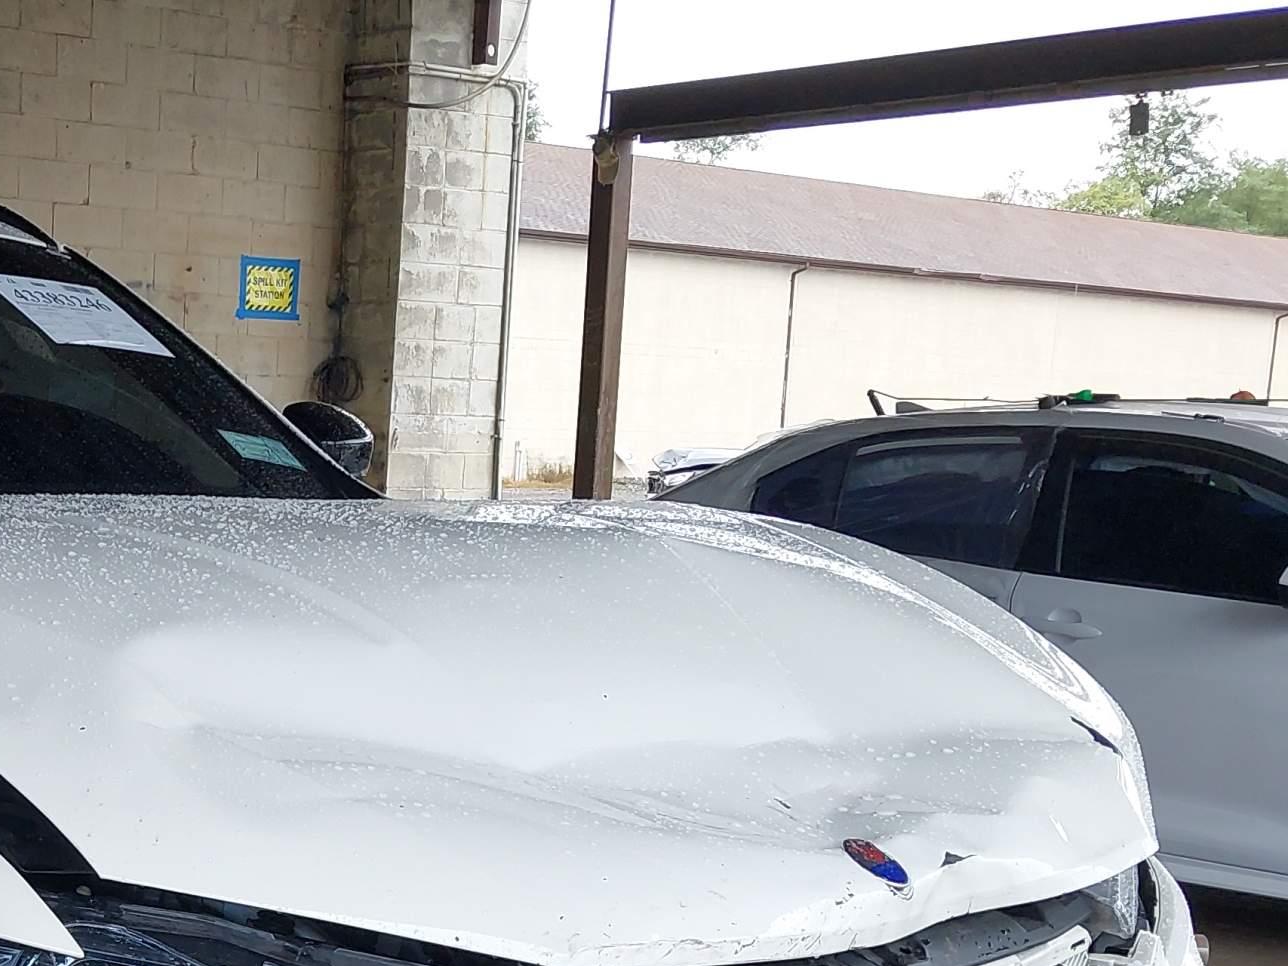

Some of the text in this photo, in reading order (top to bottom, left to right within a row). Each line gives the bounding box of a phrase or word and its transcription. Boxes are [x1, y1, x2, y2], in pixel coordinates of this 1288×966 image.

[253, 277, 288, 288] SPILL KIT
[13, 288, 112, 312] 43383246
[255, 290, 285, 300] STATION
